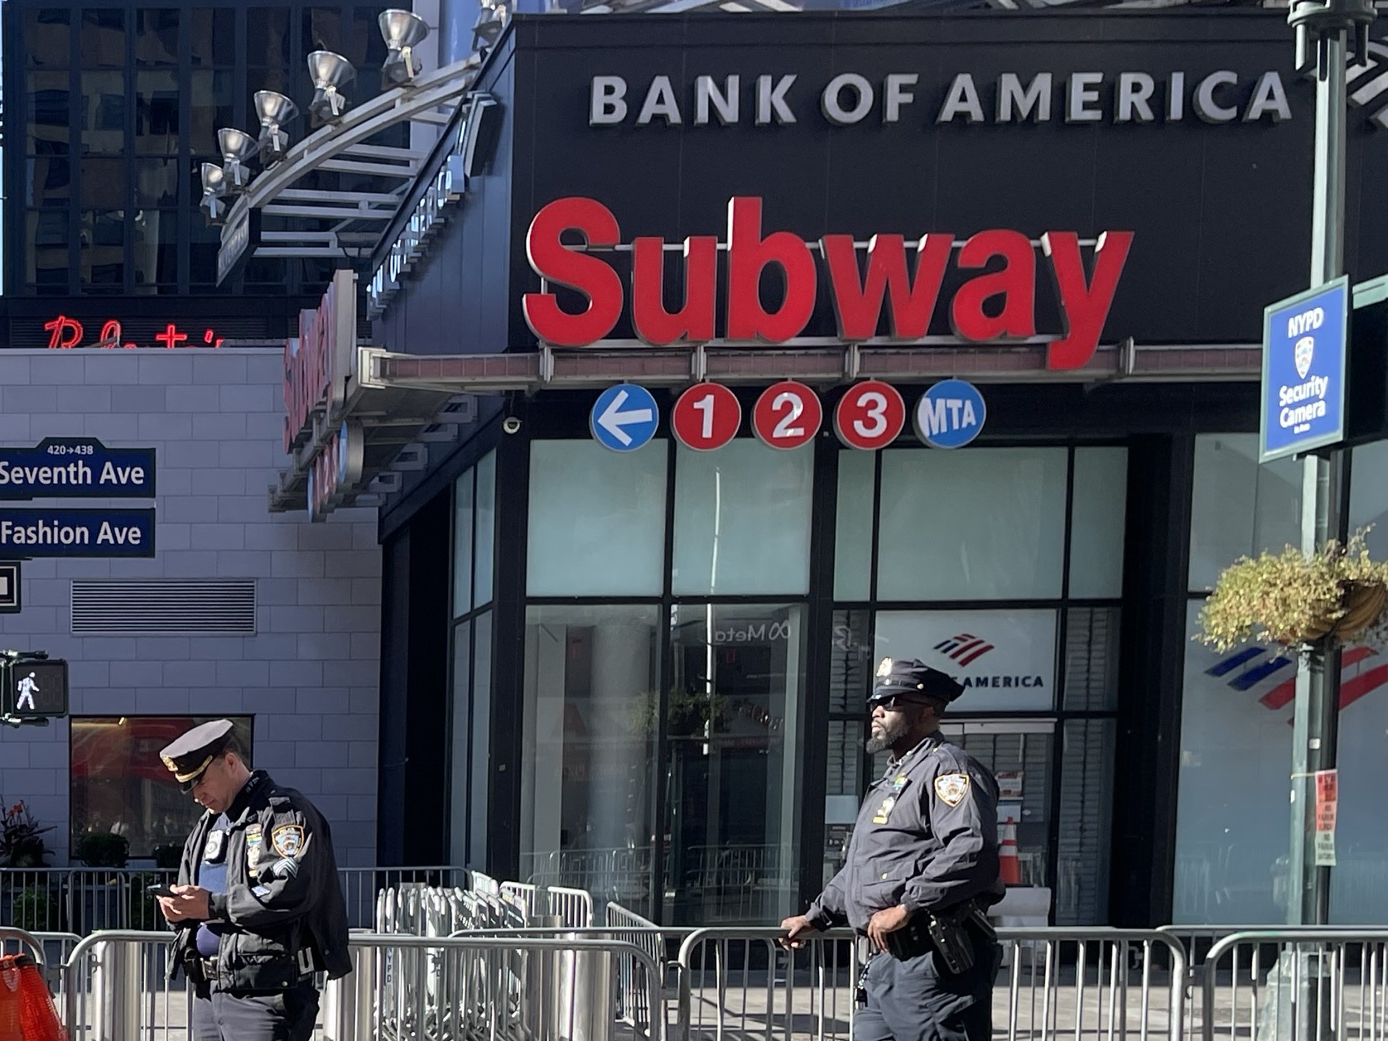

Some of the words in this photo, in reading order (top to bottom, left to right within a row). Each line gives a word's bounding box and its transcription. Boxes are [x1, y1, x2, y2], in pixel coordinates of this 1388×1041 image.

[589, 73, 797, 126] BANK
[820, 72, 919, 126] OF
[935, 70, 1292, 125] AMERICA
[522, 195, 1135, 371] Subway
[1287, 307, 1325, 339] NYPD
[1279, 375, 1329, 407] Security
[693, 394, 715, 439] 1
[771, 392, 805, 438] 2
[853, 392, 888, 438] 3
[917, 397, 976, 438] MTA
[1279, 400, 1326, 428] Camera
[46, 445, 66, 455] 420
[74, 445, 94, 455] 438
[99, 461, 145, 485] Ave
[1, 520, 89, 544] Fashion
[96, 521, 142, 544] Ave
[963, 676, 1044, 688] AMERICA
